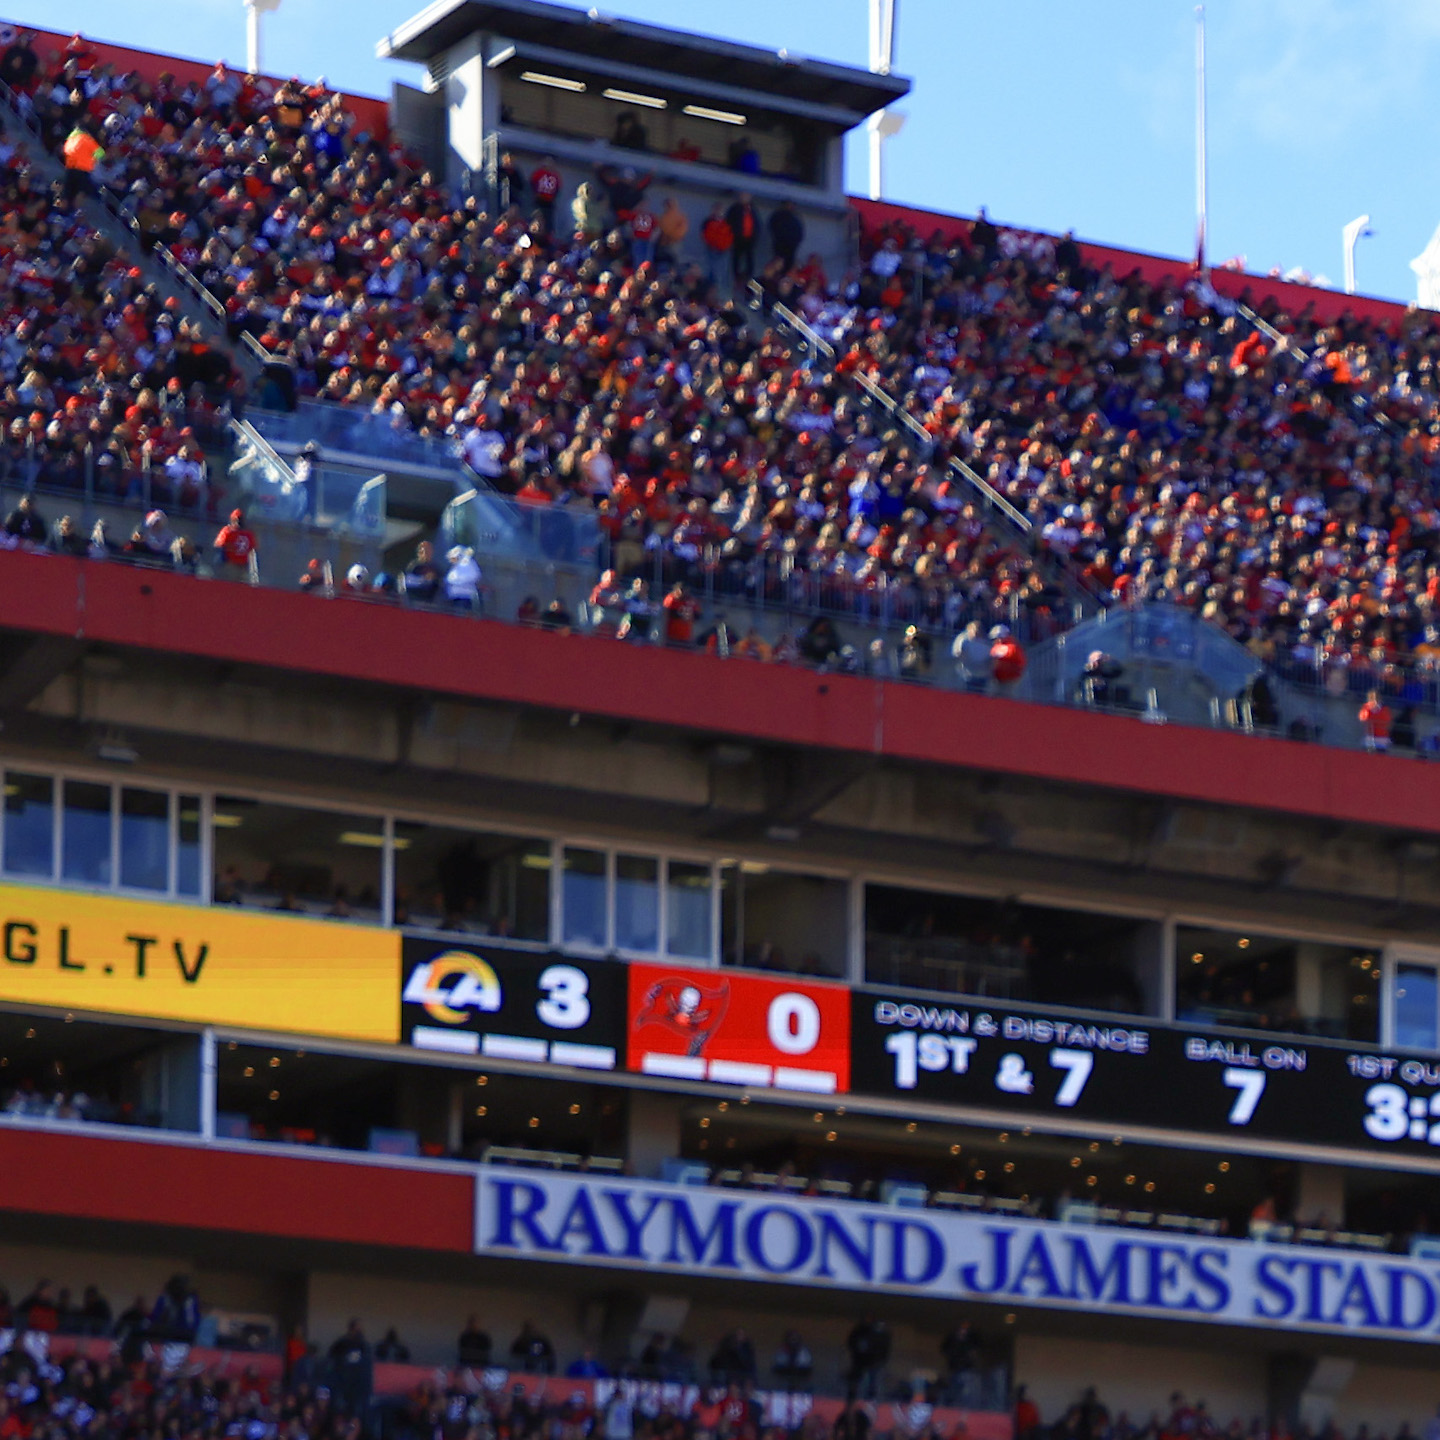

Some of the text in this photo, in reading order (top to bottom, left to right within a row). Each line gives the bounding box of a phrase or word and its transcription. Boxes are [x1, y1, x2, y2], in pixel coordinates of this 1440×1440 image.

[4, 921, 209, 983] GL.TV
[536, 965, 591, 1030] 3
[767, 991, 821, 1055] 0
[874, 1000, 1150, 1055] DOWN & DISTANCE
[885, 1030, 1094, 1107] 1ST & 7
[1184, 1037, 1307, 1072] BALL ON
[1346, 1053, 1398, 1081] 1ST
[1223, 1067, 1267, 1126] 7
[488, 1178, 945, 1287] RAYMOND
[958, 1225, 1231, 1313] JAMES
